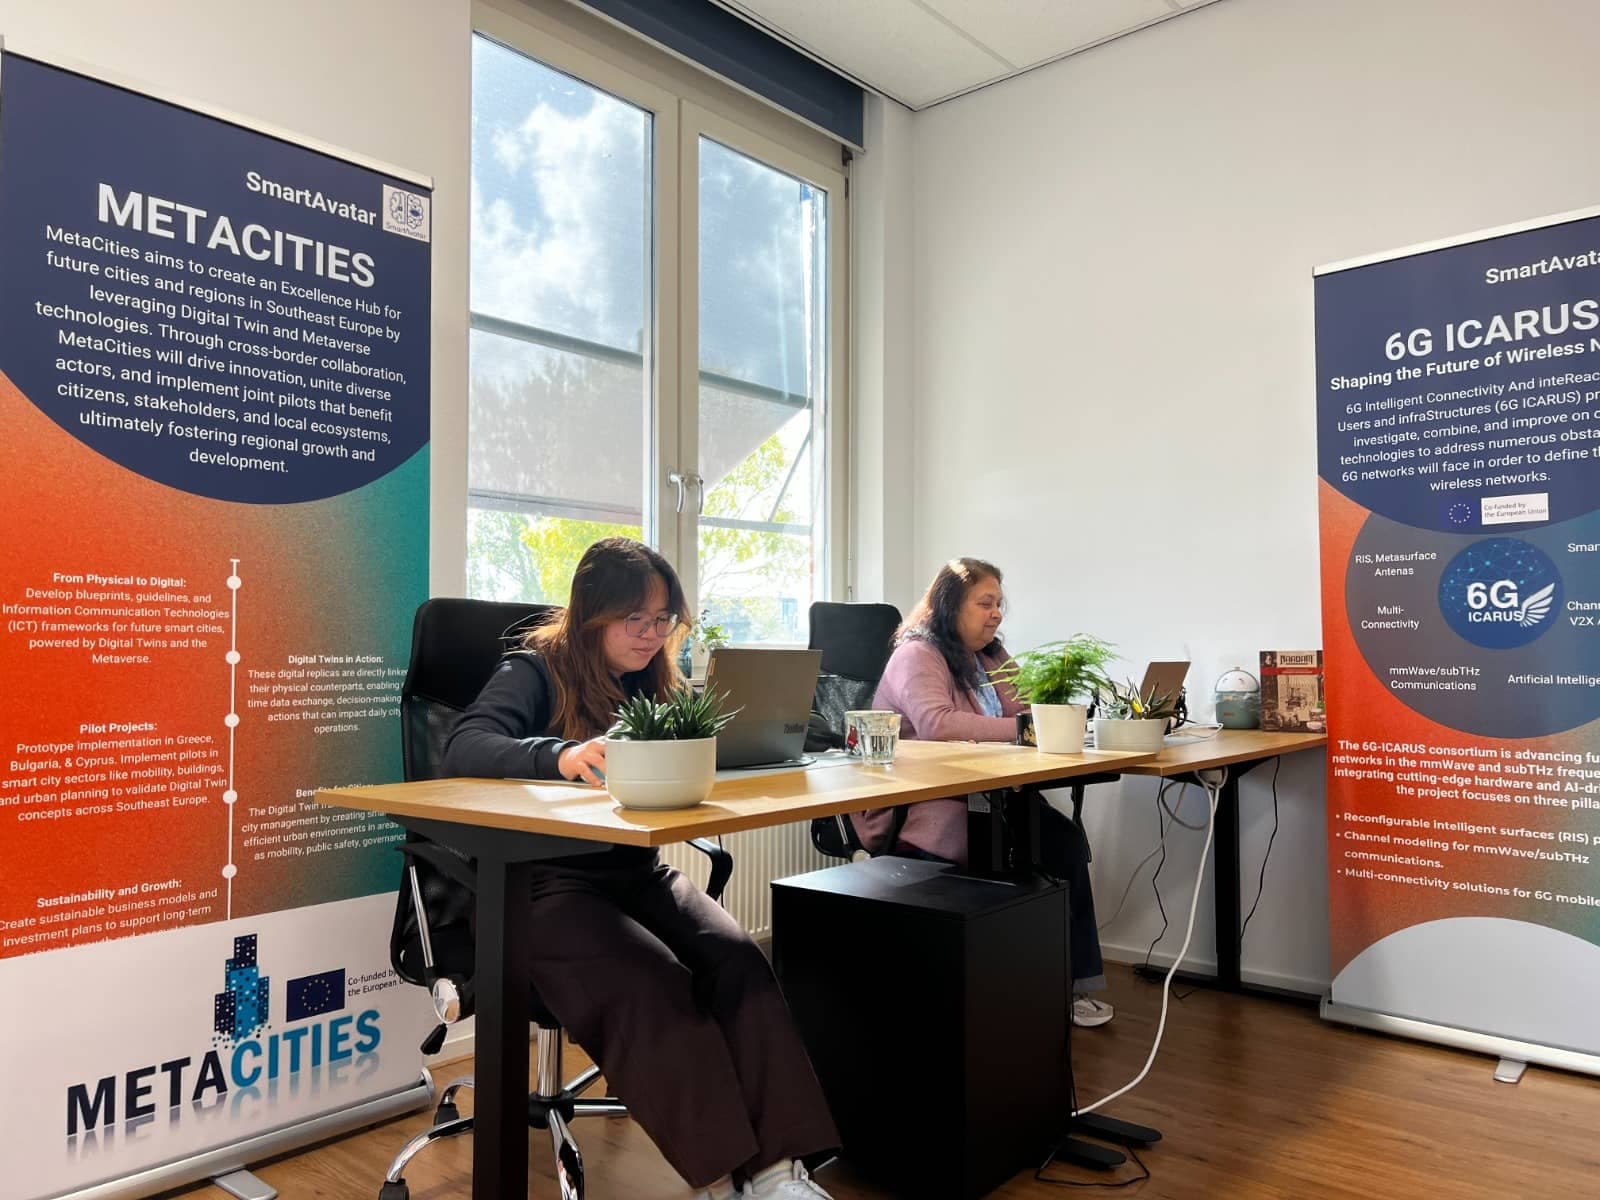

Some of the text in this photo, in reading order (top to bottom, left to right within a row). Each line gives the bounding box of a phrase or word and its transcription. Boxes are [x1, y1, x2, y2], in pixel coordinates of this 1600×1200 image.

[246, 171, 376, 225] SmartAvatar
[98, 182, 374, 287] METACITIES
[46, 225, 401, 319] MetaCities aims to create an Excellence Hub for
[46, 250, 400, 343] future cities and regions in Southeast Europe by
[90, 284, 370, 355] leveraging Digital Twin and Metaverse
[1385, 300, 1599, 360] 6G ICARUS
[35, 301, 406, 384] technologies. Through cross-border collaboration,
[58, 329, 391, 400] MetaCities will drive innovation, unite diverse
[1330, 372, 1392, 390] Shaping
[1395, 366, 1422, 380] the
[1426, 359, 1479, 376] Future
[1484, 351, 1502, 367] of
[1506, 343, 1584, 363] Wireless
[1346, 377, 1534, 414] 6G Intelligent Connectivity And
[1353, 411, 1589, 447] investigate, combine, and improve on
[189, 448, 288, 472] development.
[1430, 470, 1550, 490] wireless networks.
[1355, 551, 1436, 563] RIS, Metasurface
[53, 572, 186, 588] From Physical to Digital:
[1374, 567, 1414, 576] Antenas
[25, 587, 211, 603] Develop blueprints, guidelines, and
[1467, 579, 1518, 609] 6G
[2, 603, 229, 620] Information Communication Technologies
[1377, 605, 1404, 614] Multi-
[1468, 611, 1523, 622] ICARUS
[1360, 619, 1419, 630] Connectivity
[1569, 616, 1594, 626] V2X
[92, 654, 151, 663] Metaverse.
[288, 655, 316, 665] Digital
[318, 655, 344, 663] Twins
[345, 655, 353, 663] in
[1389, 666, 1480, 675] mmWave/subTHz
[1507, 674, 1553, 684] Artificial
[249, 683, 270, 693] their
[272, 682, 308, 694] physical
[366, 681, 399, 691] enabling
[1390, 679, 1476, 690] Communications
[247, 699, 268, 708] time
[269, 697, 290, 707] data
[336, 694, 401, 704] decision-making
[79, 722, 157, 734] Pilot Projects:
[16, 735, 213, 753] Prototype implementation in Greece,
[1338, 740, 1582, 764] The 6G-ICARUS consortium is advancing
[10, 748, 218, 771] Bulgaria, & Cyprus. Implement pilots in
[17, 796, 209, 821] concepts across Southeast Europe.
[248, 807, 266, 816] The
[268, 803, 296, 816] Digital
[298, 801, 319, 811] Twin
[1344, 812, 1589, 845] Reconfigurable intelligent surfaces (RIS)
[1344, 831, 1589, 864] Channel modeling for mmWave/subTHz
[1344, 851, 1444, 868] communications.
[37, 878, 181, 908] Sustainability and Growth:
[1345, 868, 1552, 900] Multi-connectivity solutions for 6G
[0, 887, 217, 930] Create sustainable business models and
[3, 927, 68, 947] investment
[71, 923, 102, 938] plans
[105, 921, 116, 930] to
[119, 913, 160, 928] support
[163, 905, 211, 920] long-term
[348, 970, 387, 986] Co-funded
[348, 988, 361, 997] the
[363, 979, 397, 994] European
[67, 1009, 381, 1137] METACITIES
